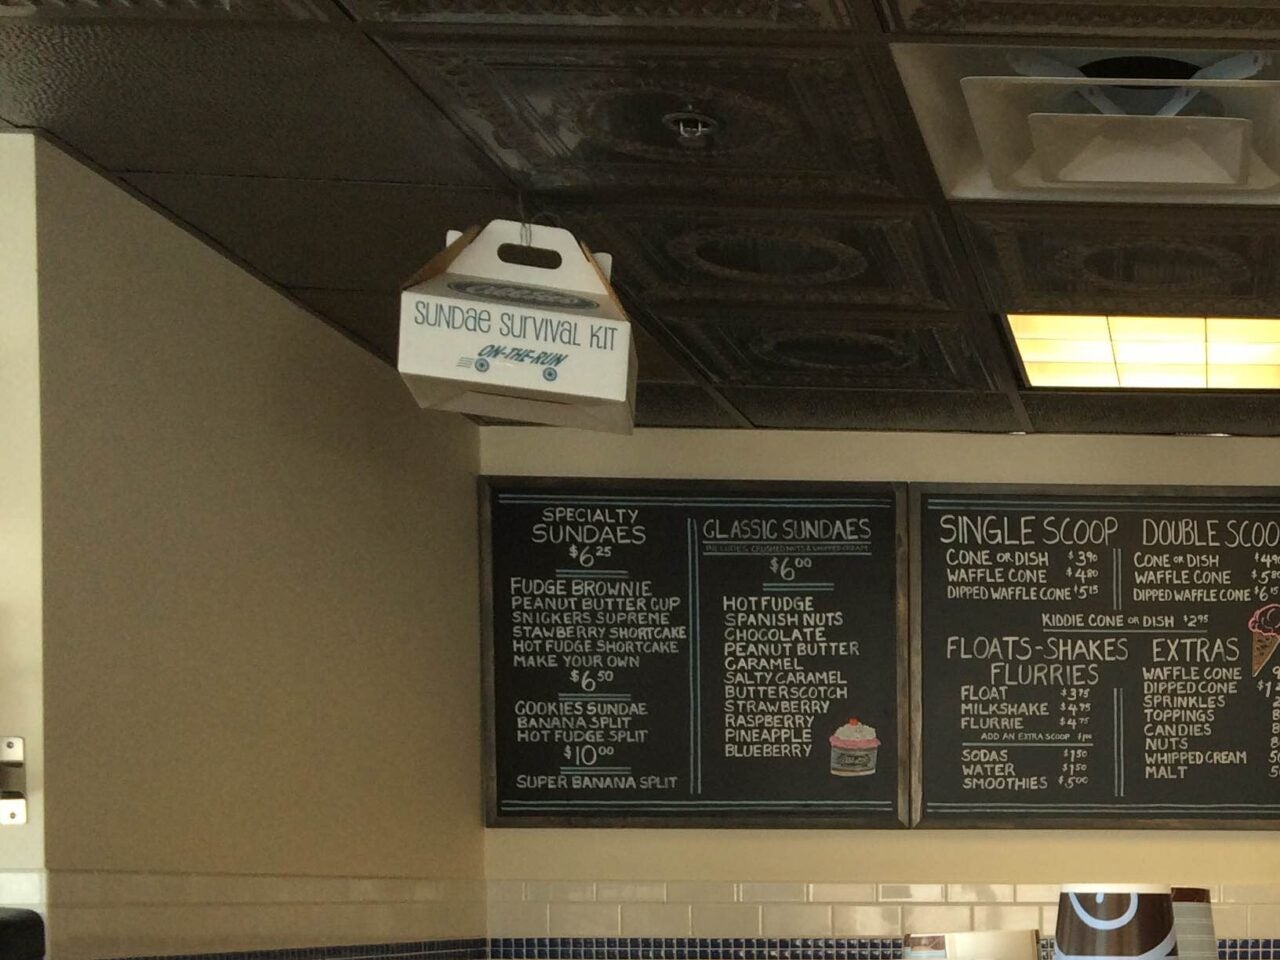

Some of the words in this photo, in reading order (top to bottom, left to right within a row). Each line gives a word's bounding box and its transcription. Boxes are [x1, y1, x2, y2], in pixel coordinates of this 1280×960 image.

[589, 324, 618, 350] KIT
[477, 344, 568, 367] ON-THE-RUN
[542, 507, 638, 524] SPECIALTY
[531, 524, 646, 544] SUNDAES
[703, 519, 778, 539] CLASSIC
[782, 518, 871, 540] SUNDAES
[940, 514, 1036, 545] SINGLE
[1042, 516, 1119, 546] SCOOP
[1142, 518, 1220, 546] DOUBLE
[946, 548, 992, 566] CONE
[997, 553, 1013, 562] OR
[1015, 551, 1049, 566] DISH
[946, 568, 1004, 582] WAFFLE
[1008, 568, 1047, 583] CONE
[510, 577, 566, 595] FUDGE
[571, 579, 652, 597] BROWNIE
[511, 596, 577, 610] PEANUT
[582, 597, 646, 611] BUTTER
[650, 596, 680, 611] CUP
[511, 611, 592, 625] SNICKERS
[595, 612, 670, 625] SUPREME
[725, 613, 799, 626] SPANISH
[803, 612, 843, 626] NUTS
[1042, 613, 1084, 626] KIDDIE
[1088, 614, 1124, 626] CONE
[1128, 616, 1139, 625] OR
[1143, 615, 1174, 627] DISH
[609, 626, 687, 640] SHORTCAKE
[724, 628, 826, 641] CHOCOLATE
[947, 636, 1128, 661] FLOATS-SHAKES
[1152, 637, 1240, 662] EXTRAS
[513, 654, 558, 668] MAKE
[563, 655, 604, 668] YOUR
[607, 655, 640, 667] OWN
[725, 657, 804, 670] CARAMEL
[724, 671, 772, 684] SALTY
[775, 671, 847, 684] CARAMEL
[991, 662, 1099, 685] FLURRIES
[725, 686, 848, 699] BUTTERSCOTCH
[961, 685, 1008, 700] FLOAT
[515, 700, 583, 715] COOKIES
[586, 702, 648, 715] SUNDAE
[724, 700, 830, 713] STRAWBERRY
[1143, 695, 1225, 708] SPRINKLES
[961, 703, 1049, 716] MILKSHAKE
[1144, 709, 1215, 722] TOPPINGS
[517, 717, 587, 729] BANANA
[589, 717, 632, 729] SPLIT
[725, 714, 814, 727] RASPBERRY
[961, 717, 1024, 730] FLURRIE
[725, 729, 812, 743] PINEAPPLE
[1018, 732, 1043, 740] EXTRA
[1144, 723, 1212, 736] CANDIES
[725, 744, 812, 757] BLUEBERRY
[1145, 737, 1188, 750] NUTS
[961, 749, 1008, 762] SODAS
[1145, 751, 1203, 764] WHIPPED
[1205, 751, 1247, 764] CREAM
[962, 764, 1015, 776] WATER
[1145, 766, 1188, 779] MALT
[962, 776, 1048, 790] SMOOTHIES
